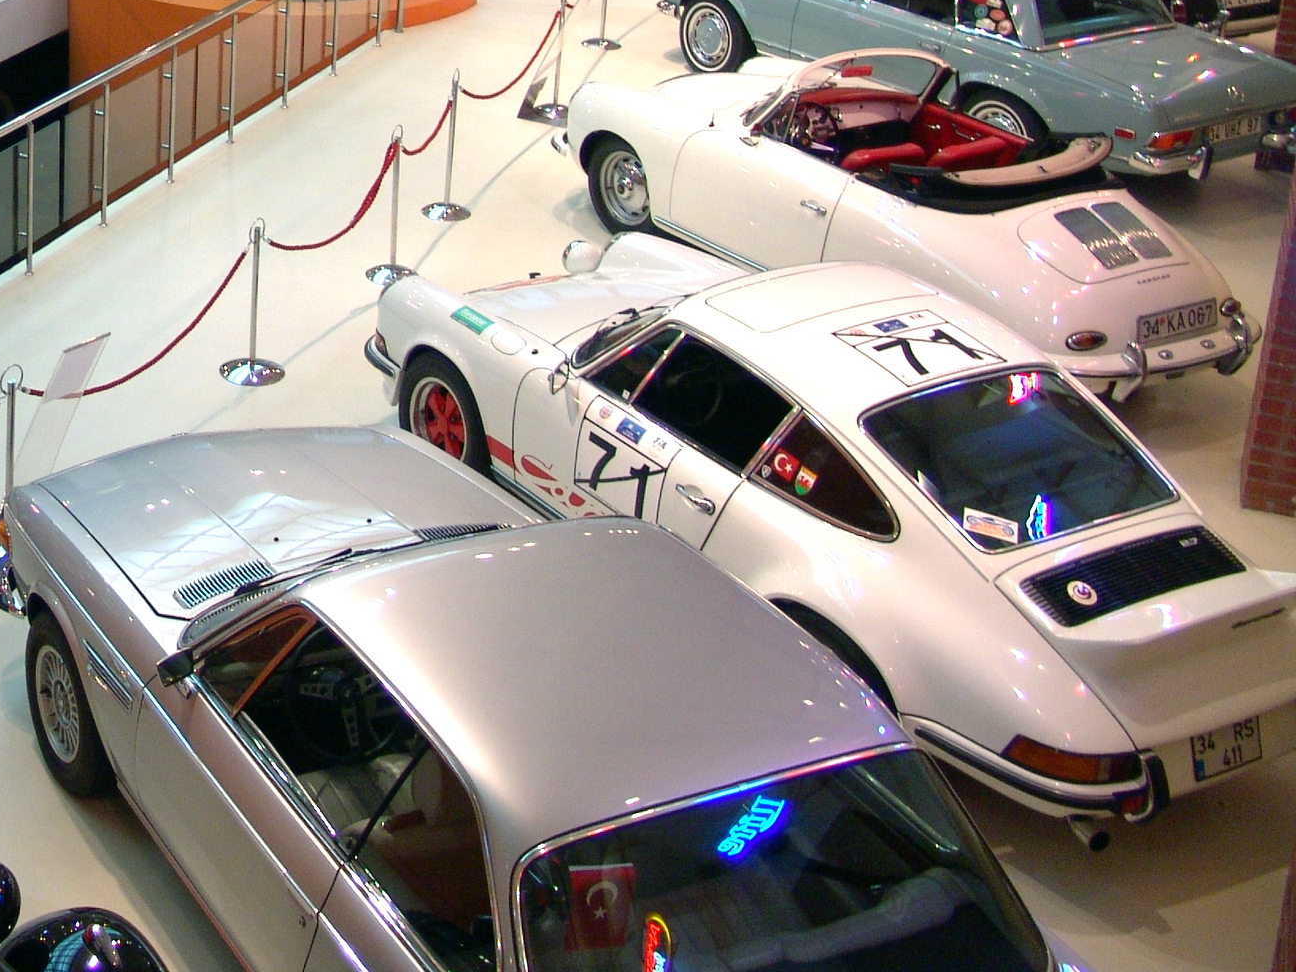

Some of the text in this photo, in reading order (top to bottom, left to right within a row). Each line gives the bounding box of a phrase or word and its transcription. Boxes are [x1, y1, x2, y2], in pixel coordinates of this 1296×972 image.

[1142, 318, 1160, 339] 34
[872, 328, 985, 376] 71
[588, 431, 651, 519] 71
[1197, 718, 1255, 755] 34 RS
[1223, 743, 1243, 766] 411
